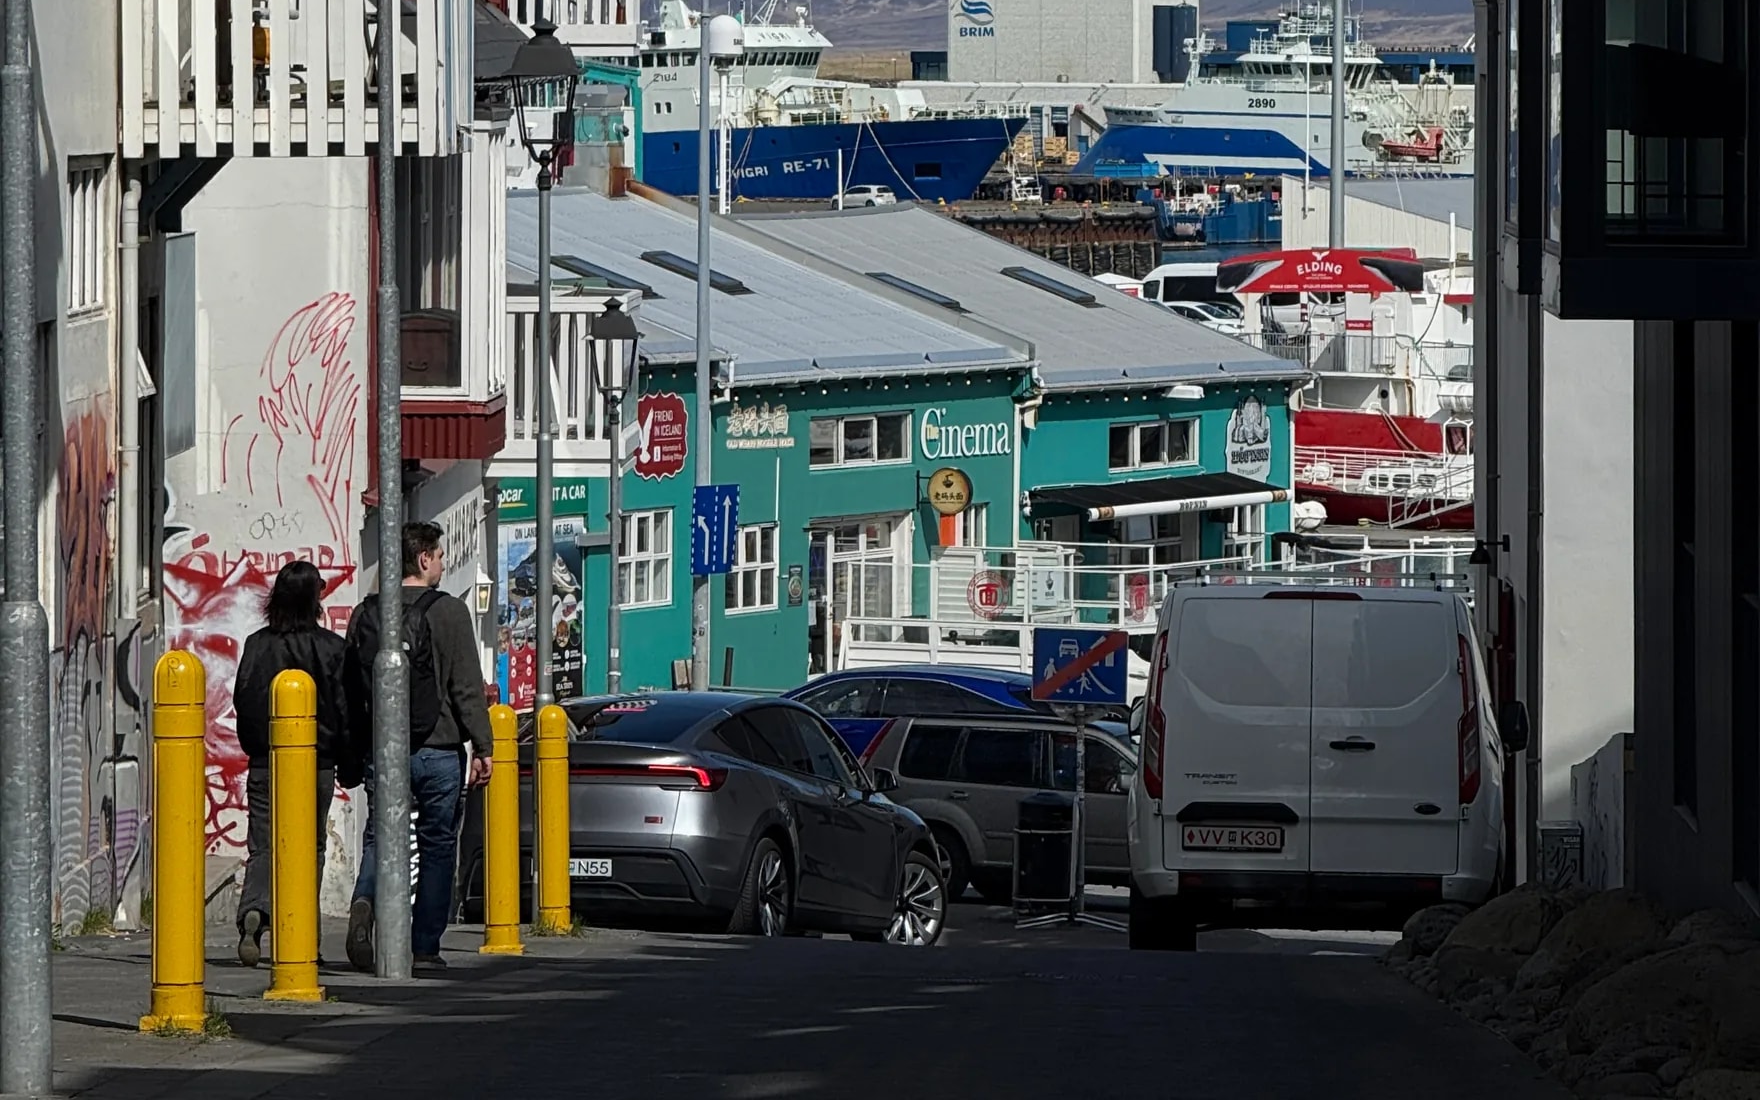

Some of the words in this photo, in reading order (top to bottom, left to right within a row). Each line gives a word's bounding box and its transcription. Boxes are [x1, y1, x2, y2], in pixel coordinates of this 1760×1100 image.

[959, 26, 995, 37] BRIM
[1247, 98, 1276, 109] 2890
[731, 166, 769, 180] VIGRI
[782, 158, 831, 175] RE-71
[1296, 261, 1343, 276] ELDING
[654, 410, 674, 422] FRIEND
[653, 425, 660, 437] IN
[661, 424, 683, 437] ICELAND
[920, 407, 1012, 459] Cinema
[561, 485, 568, 500] A
[569, 484, 586, 500] CAR
[515, 529, 523, 540] ON
[555, 525, 562, 536] AT
[562, 523, 574, 535] SEA
[1199, 828, 1225, 846] VV
[1240, 830, 1278, 847] K30
[577, 861, 610, 875] N55
